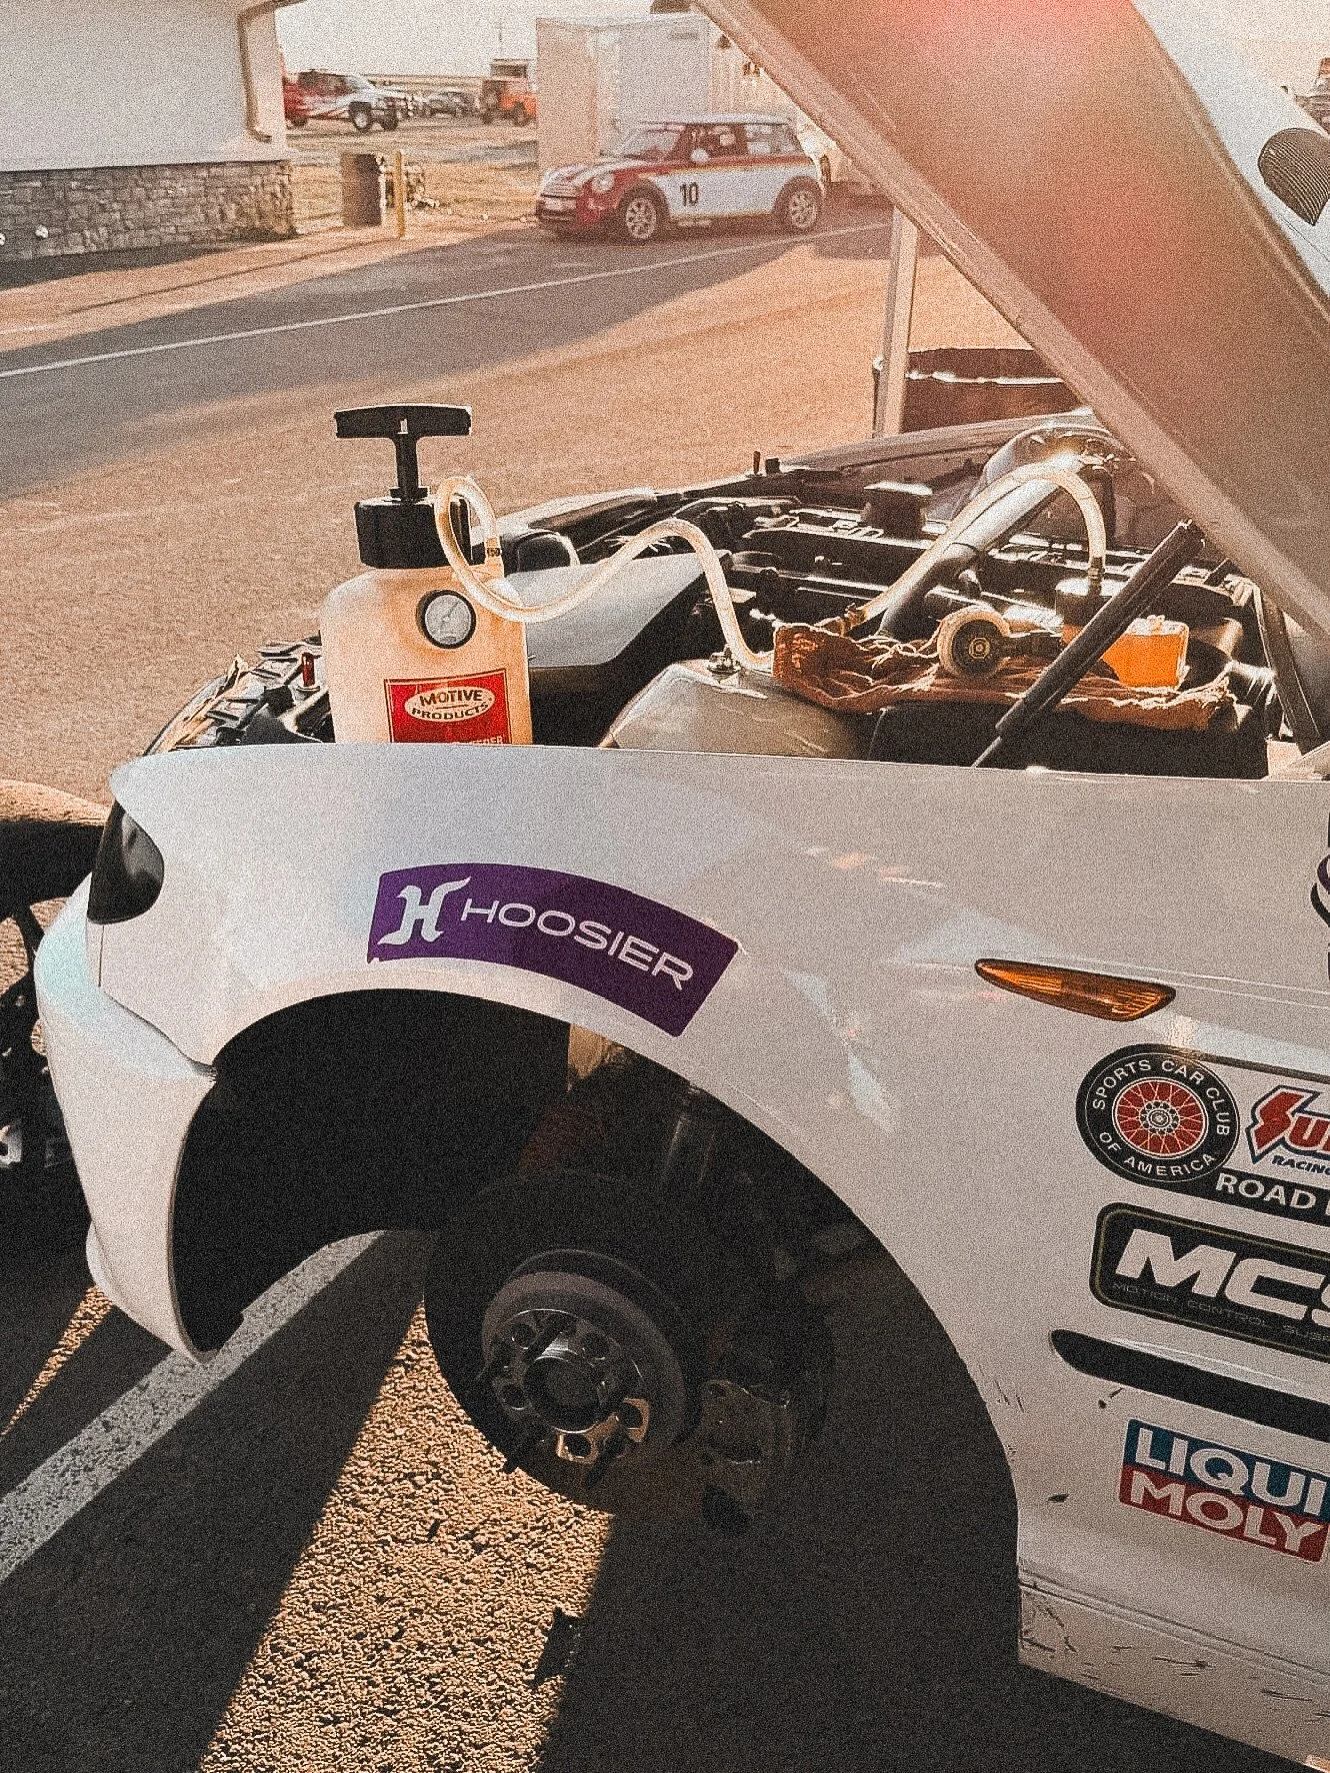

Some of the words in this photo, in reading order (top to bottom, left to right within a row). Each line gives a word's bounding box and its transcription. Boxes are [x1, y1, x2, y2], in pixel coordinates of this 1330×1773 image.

[679, 182, 699, 207] 10
[411, 701, 489, 720] PRODUCTS
[420, 689, 483, 707] MOTIVE
[460, 898, 694, 991] HOOSIER
[1092, 1059, 1152, 1110] SPORTS
[1161, 1060, 1204, 1085] CAR
[1206, 1087, 1231, 1136] CLUB
[1100, 1131, 1121, 1152] OF
[1124, 1153, 1216, 1176] AMERICA
[1215, 1172, 1316, 1209] ROAD
[1135, 1427, 1327, 1516] LIQUI
[1130, 1470, 1324, 1552] MOLY
